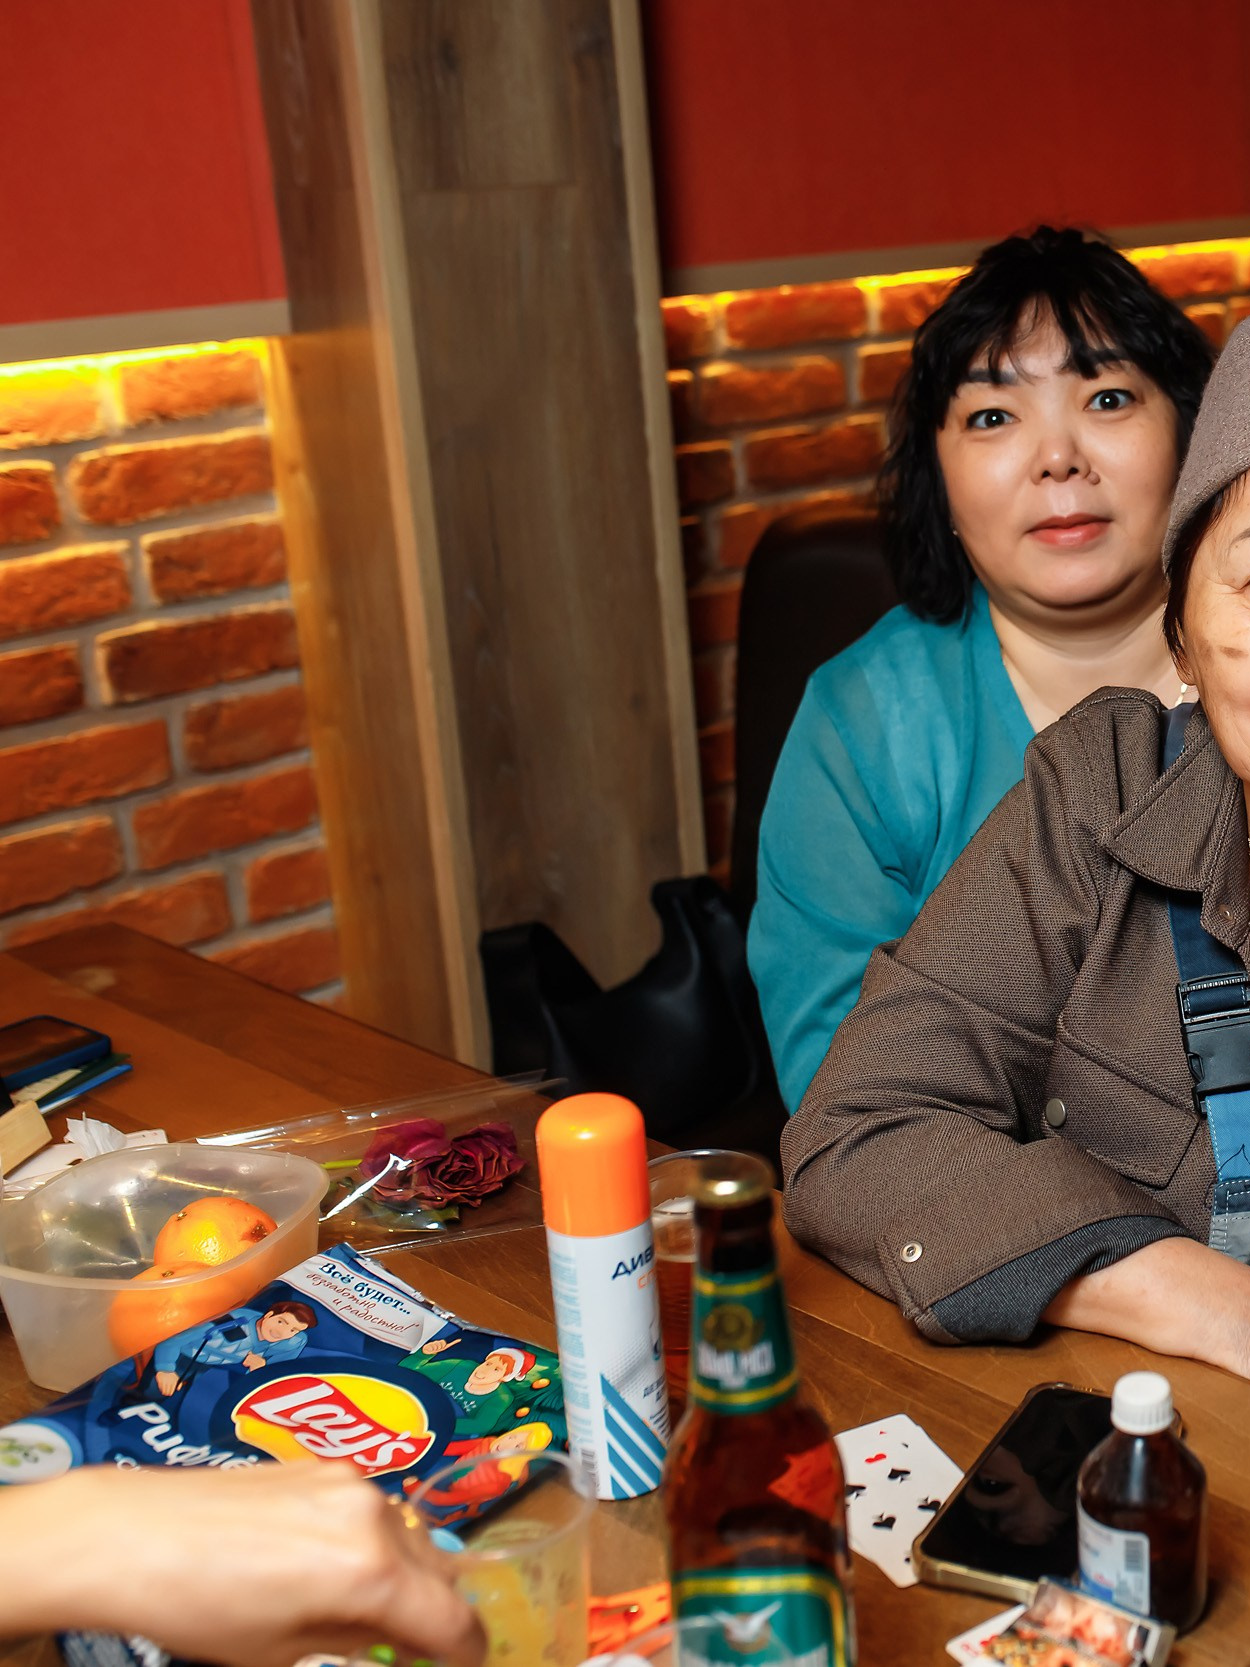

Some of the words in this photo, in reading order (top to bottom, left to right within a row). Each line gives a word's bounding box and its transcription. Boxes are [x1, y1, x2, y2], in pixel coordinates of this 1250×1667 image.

[319, 1262, 354, 1285] Всё
[306, 1273, 377, 1309] беззаботно
[332, 1297, 342, 1306] и
[250, 1382, 416, 1467] Lay's
